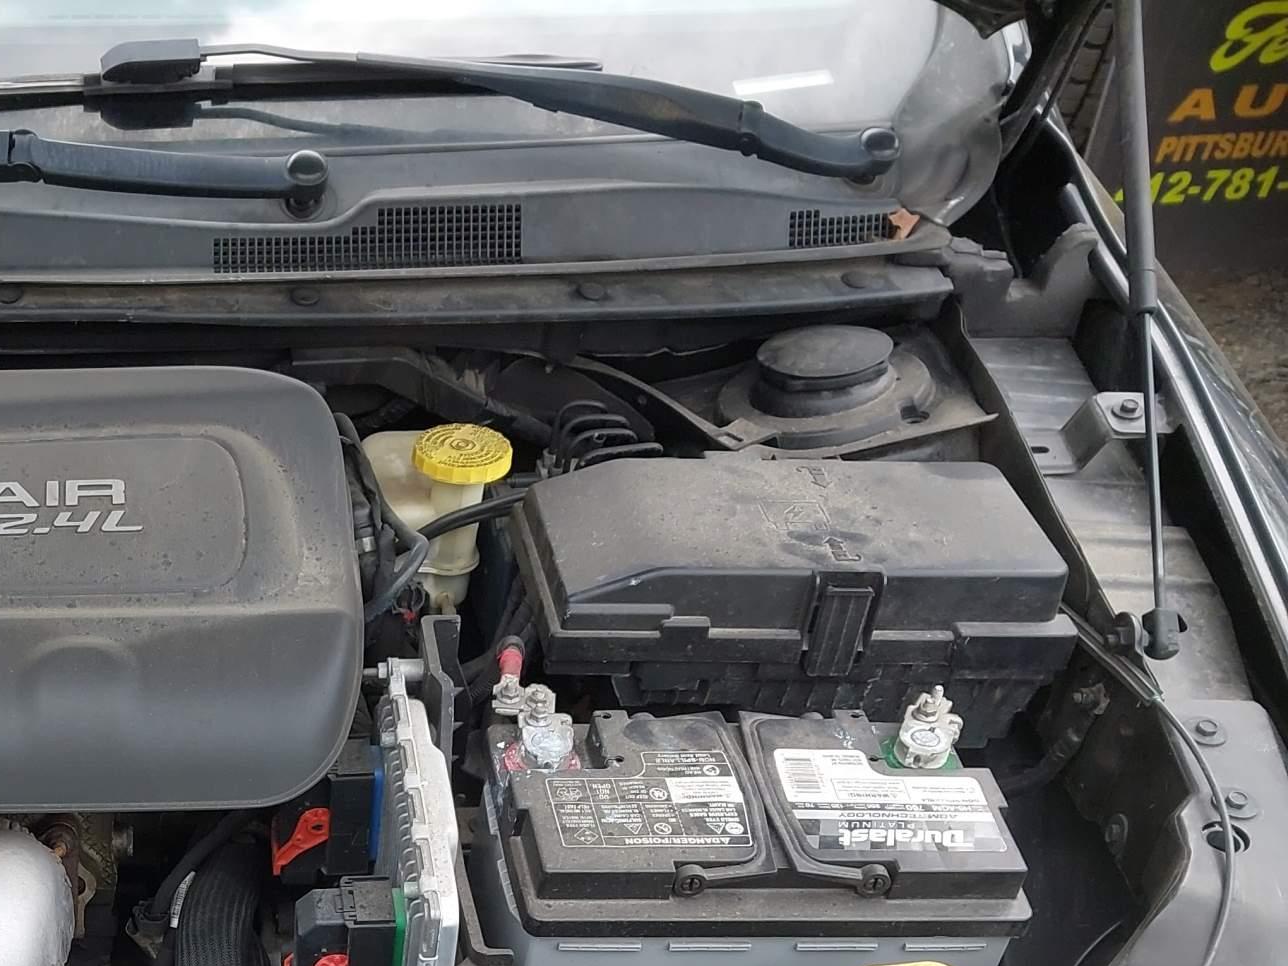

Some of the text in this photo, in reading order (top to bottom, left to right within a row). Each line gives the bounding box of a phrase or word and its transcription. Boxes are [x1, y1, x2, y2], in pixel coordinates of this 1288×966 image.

[1112, 166, 1288, 206] 12-781-
[837, 820, 916, 829] PLATINUM
[624, 837, 721, 845] DANGER/POISON
[837, 828, 974, 848] Duralast
